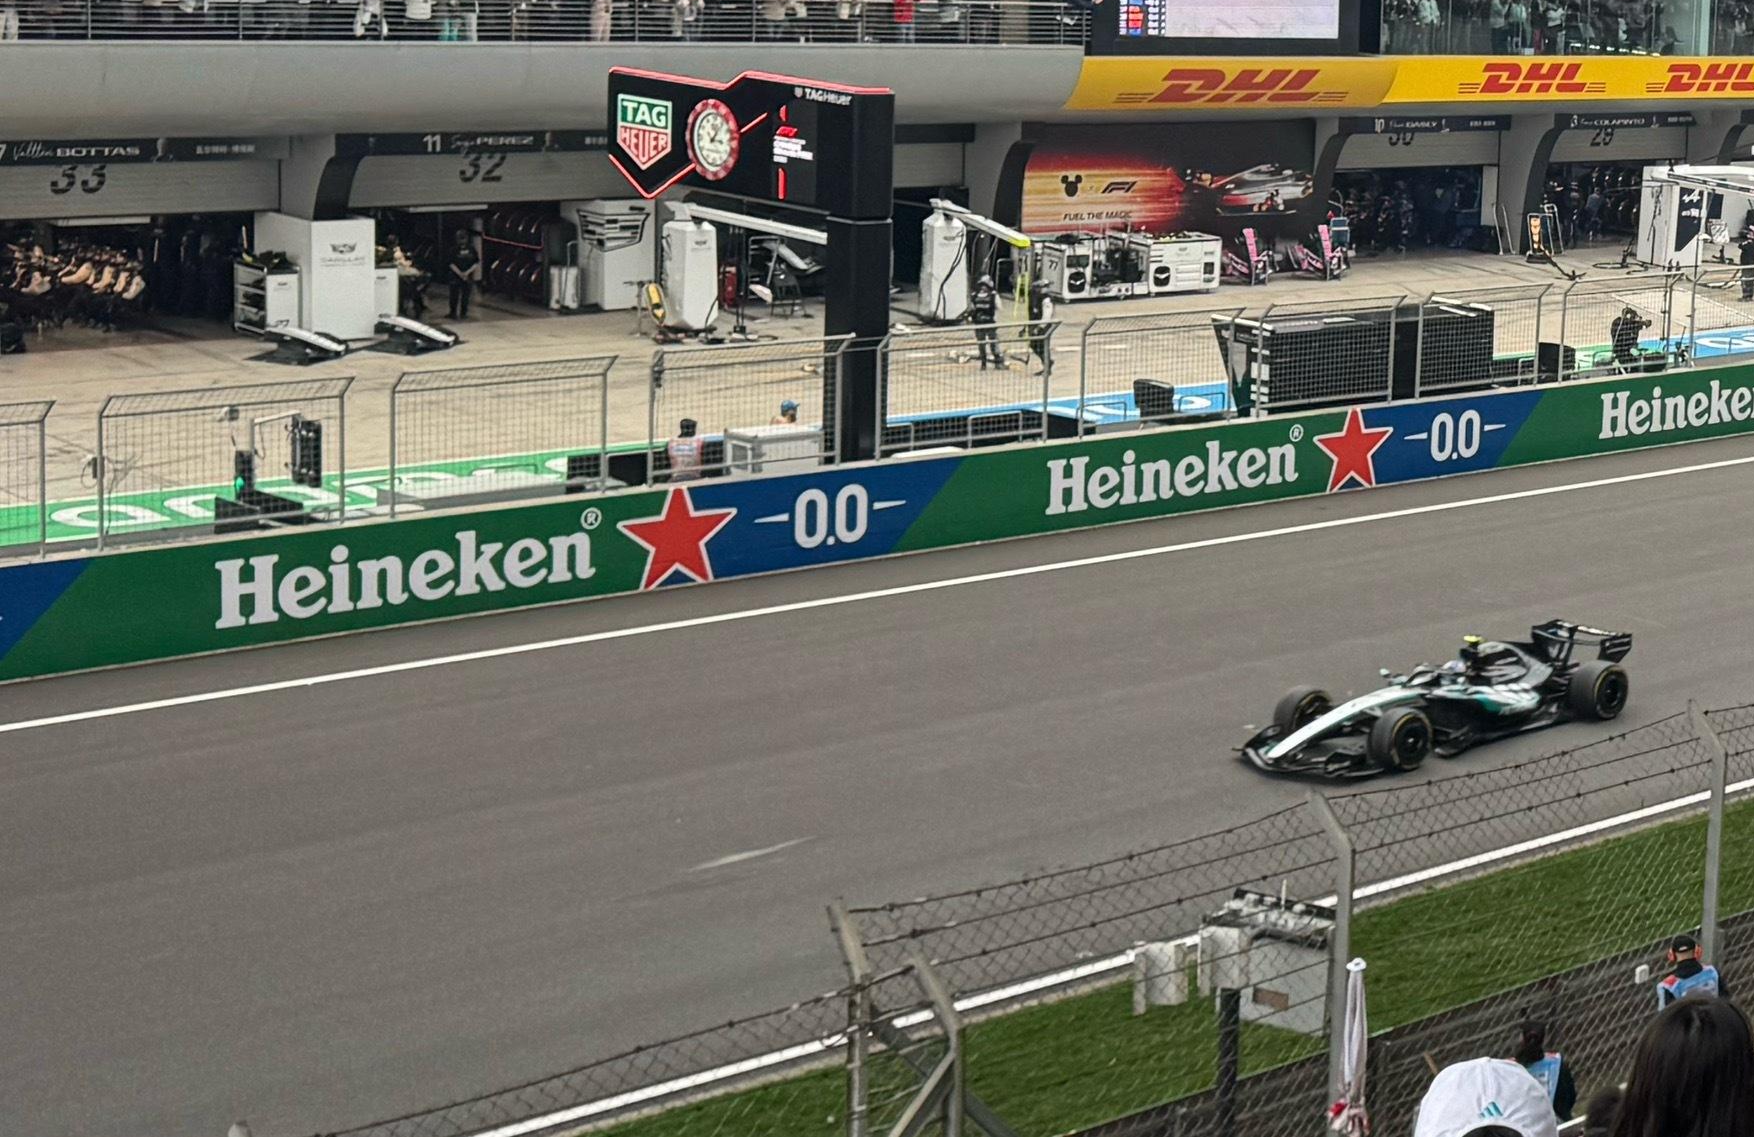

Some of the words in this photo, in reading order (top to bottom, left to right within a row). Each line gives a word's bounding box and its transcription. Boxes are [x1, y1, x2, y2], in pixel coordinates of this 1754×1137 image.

[1148, 68, 1320, 104] DHL
[1480, 62, 1586, 94] DHL
[622, 100, 667, 127] TAG
[55, 146, 141, 158] BOTTAS
[422, 134, 441, 152] 11
[621, 127, 668, 163] HEUER
[1063, 213, 1085, 222] FUEL
[1044, 440, 1298, 517] Heineken
[215, 531, 595, 630] Heineken
